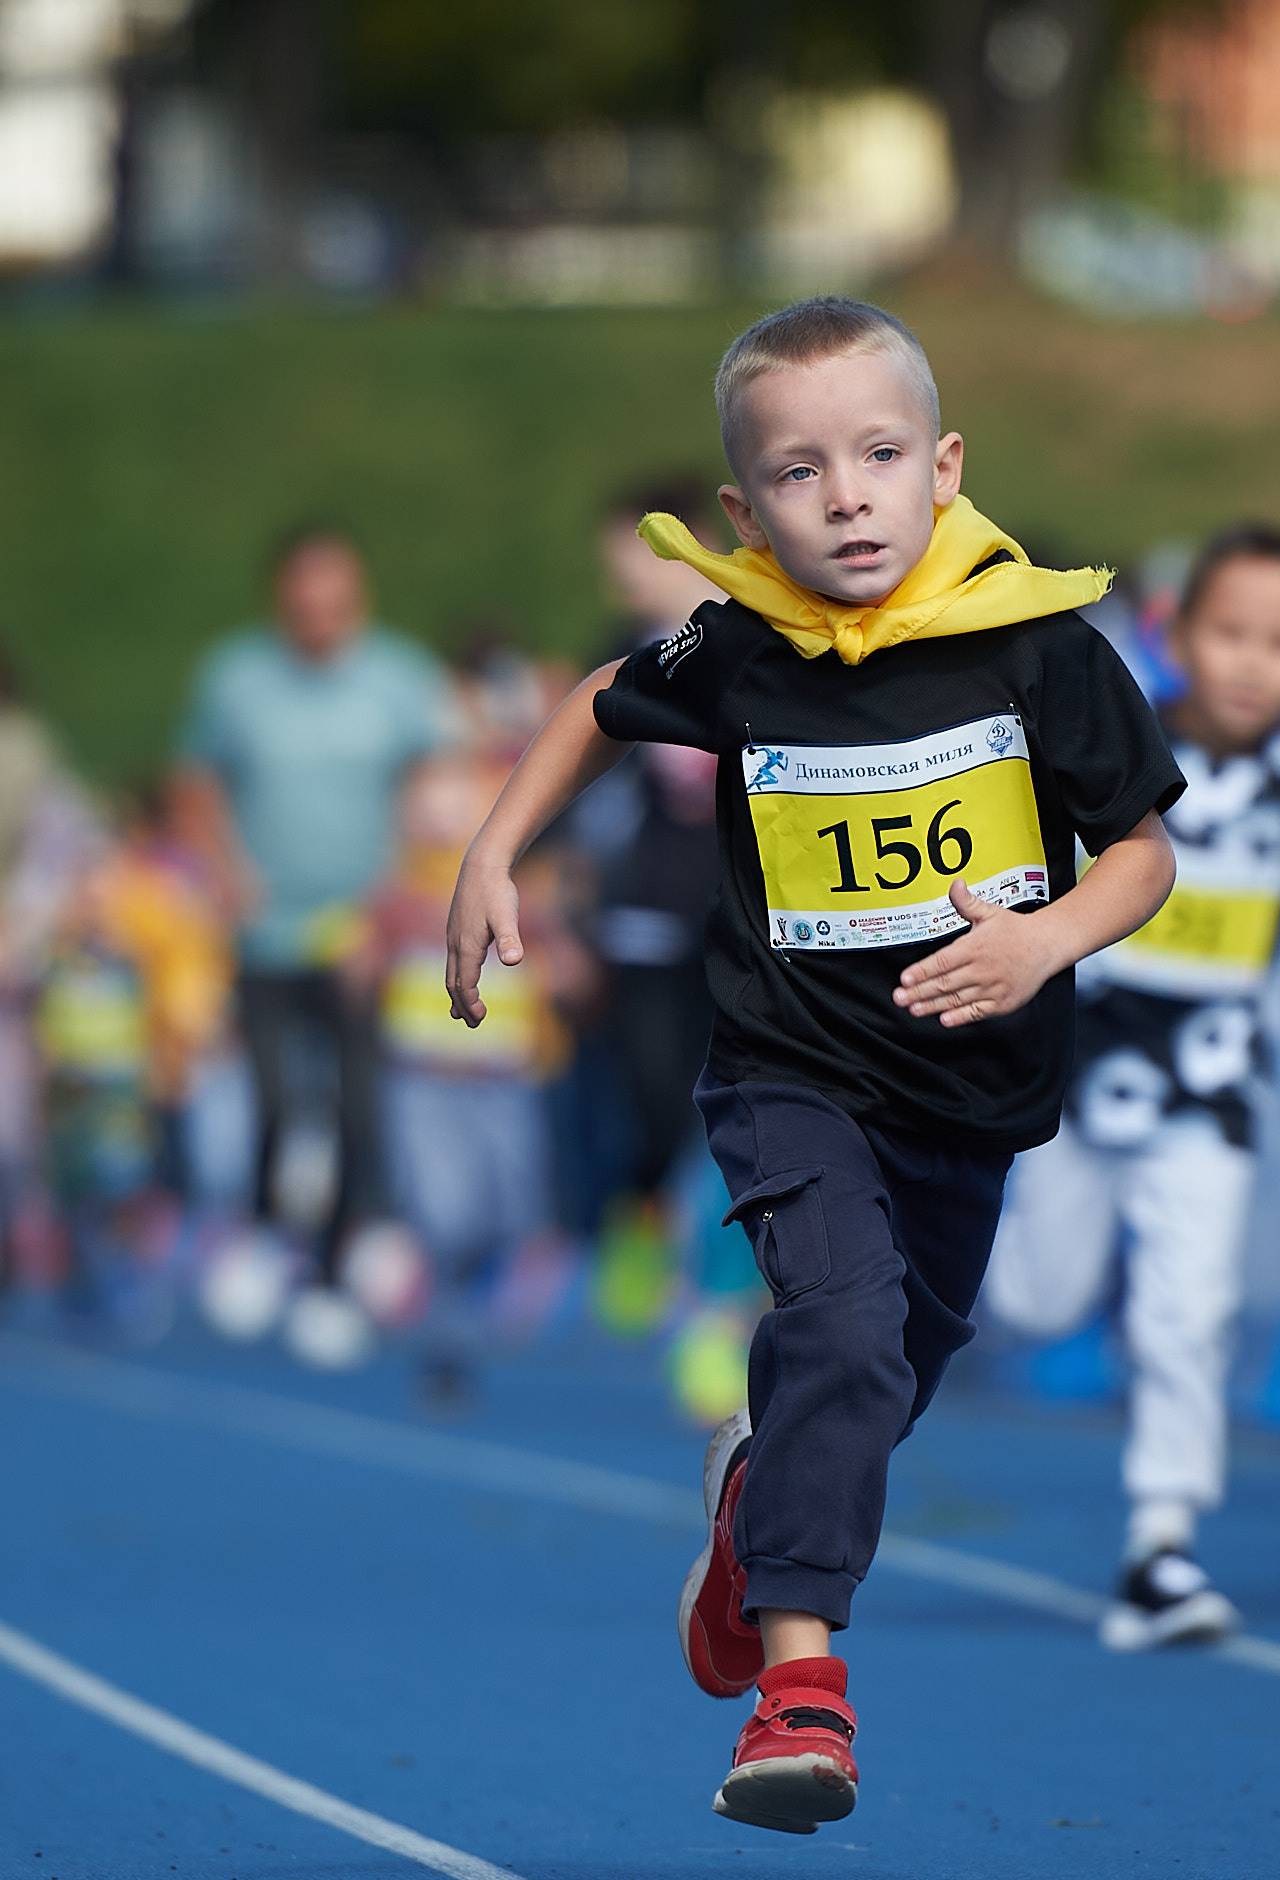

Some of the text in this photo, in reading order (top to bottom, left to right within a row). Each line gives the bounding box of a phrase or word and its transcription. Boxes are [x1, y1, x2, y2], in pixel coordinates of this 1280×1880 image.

[795, 743, 974, 781] Динамовская миля
[816, 799, 973, 893] 156
